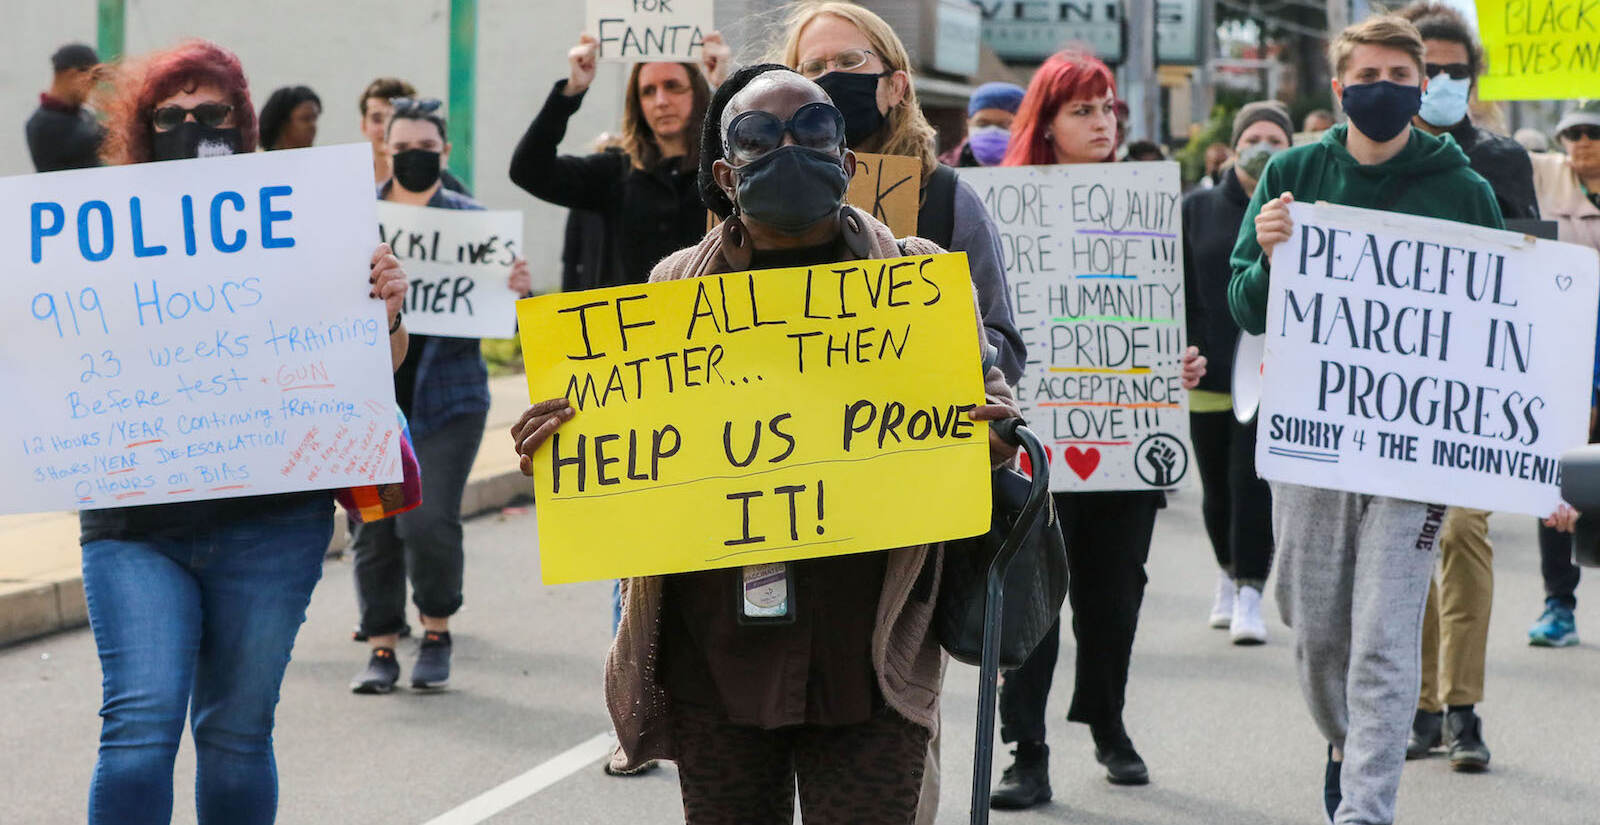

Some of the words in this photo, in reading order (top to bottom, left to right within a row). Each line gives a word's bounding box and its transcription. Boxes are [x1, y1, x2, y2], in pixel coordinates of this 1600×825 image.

[599, 19, 704, 57] FANTA
[1505, 0, 1600, 35] BLACK
[30, 185, 296, 264] POLICE
[1072, 183, 1179, 232] EQUALITY
[1297, 224, 1518, 307] PEACEFUL
[31, 286, 109, 338] 919
[134, 276, 263, 326] Hours
[557, 294, 656, 361] IF
[686, 273, 787, 340] ALL
[803, 257, 941, 320] LIVES
[1049, 283, 1180, 320] HUMANITY
[1281, 288, 1453, 362] MARCH
[1484, 318, 1533, 374] IN
[80, 350, 122, 383] 23
[176, 368, 248, 400] test
[277, 360, 329, 386] GUN
[565, 344, 763, 412] MATTER...
[786, 324, 911, 374] THEN
[1034, 375, 1181, 404] ACCEPTANCE
[1317, 360, 1545, 446] PROGRESS
[22, 436, 46, 455] 12
[177, 409, 272, 435] Continuing
[551, 424, 682, 494] HELP
[723, 413, 797, 468] US
[843, 399, 977, 453] PROVE
[1270, 414, 1344, 450] SORRY
[1353, 429, 1366, 451] 4
[1377, 432, 1419, 462] THE
[168, 472, 189, 485] on
[194, 462, 251, 484] BIAS
[724, 479, 825, 547] IT!
